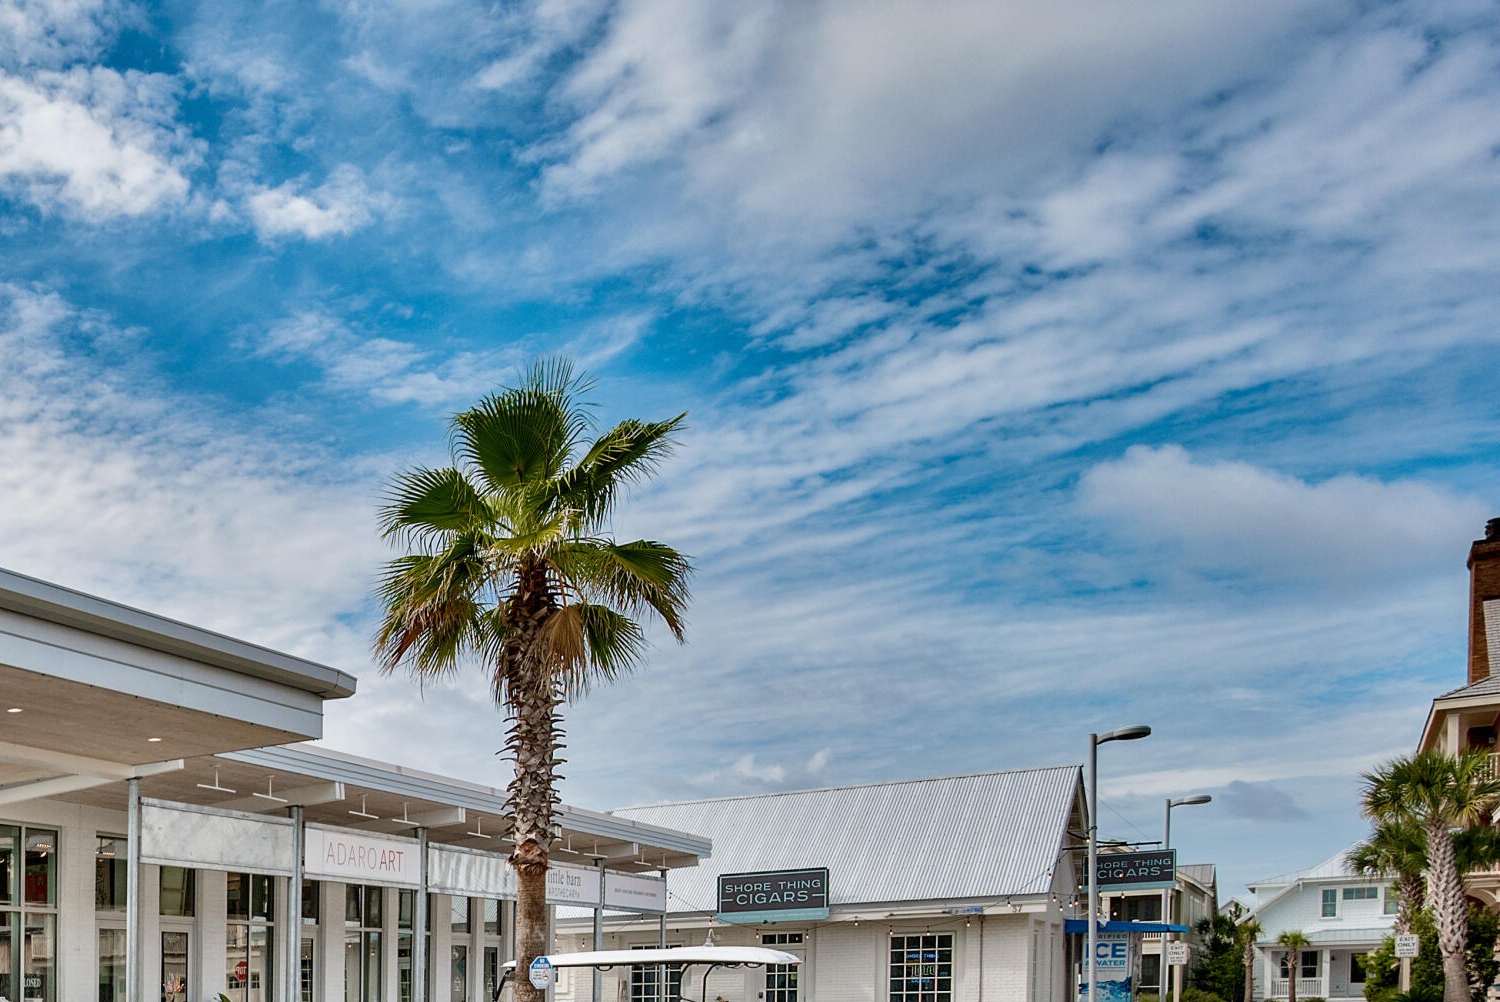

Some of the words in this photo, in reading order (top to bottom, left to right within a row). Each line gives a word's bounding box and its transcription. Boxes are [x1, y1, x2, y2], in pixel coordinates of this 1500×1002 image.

[1097, 861, 1128, 869] HORE
[1134, 858, 1171, 867] THING
[1097, 867, 1160, 879] CIGARS
[725, 882, 771, 893] SHORE
[778, 879, 821, 890] THING
[736, 890, 809, 905] CIGARS
